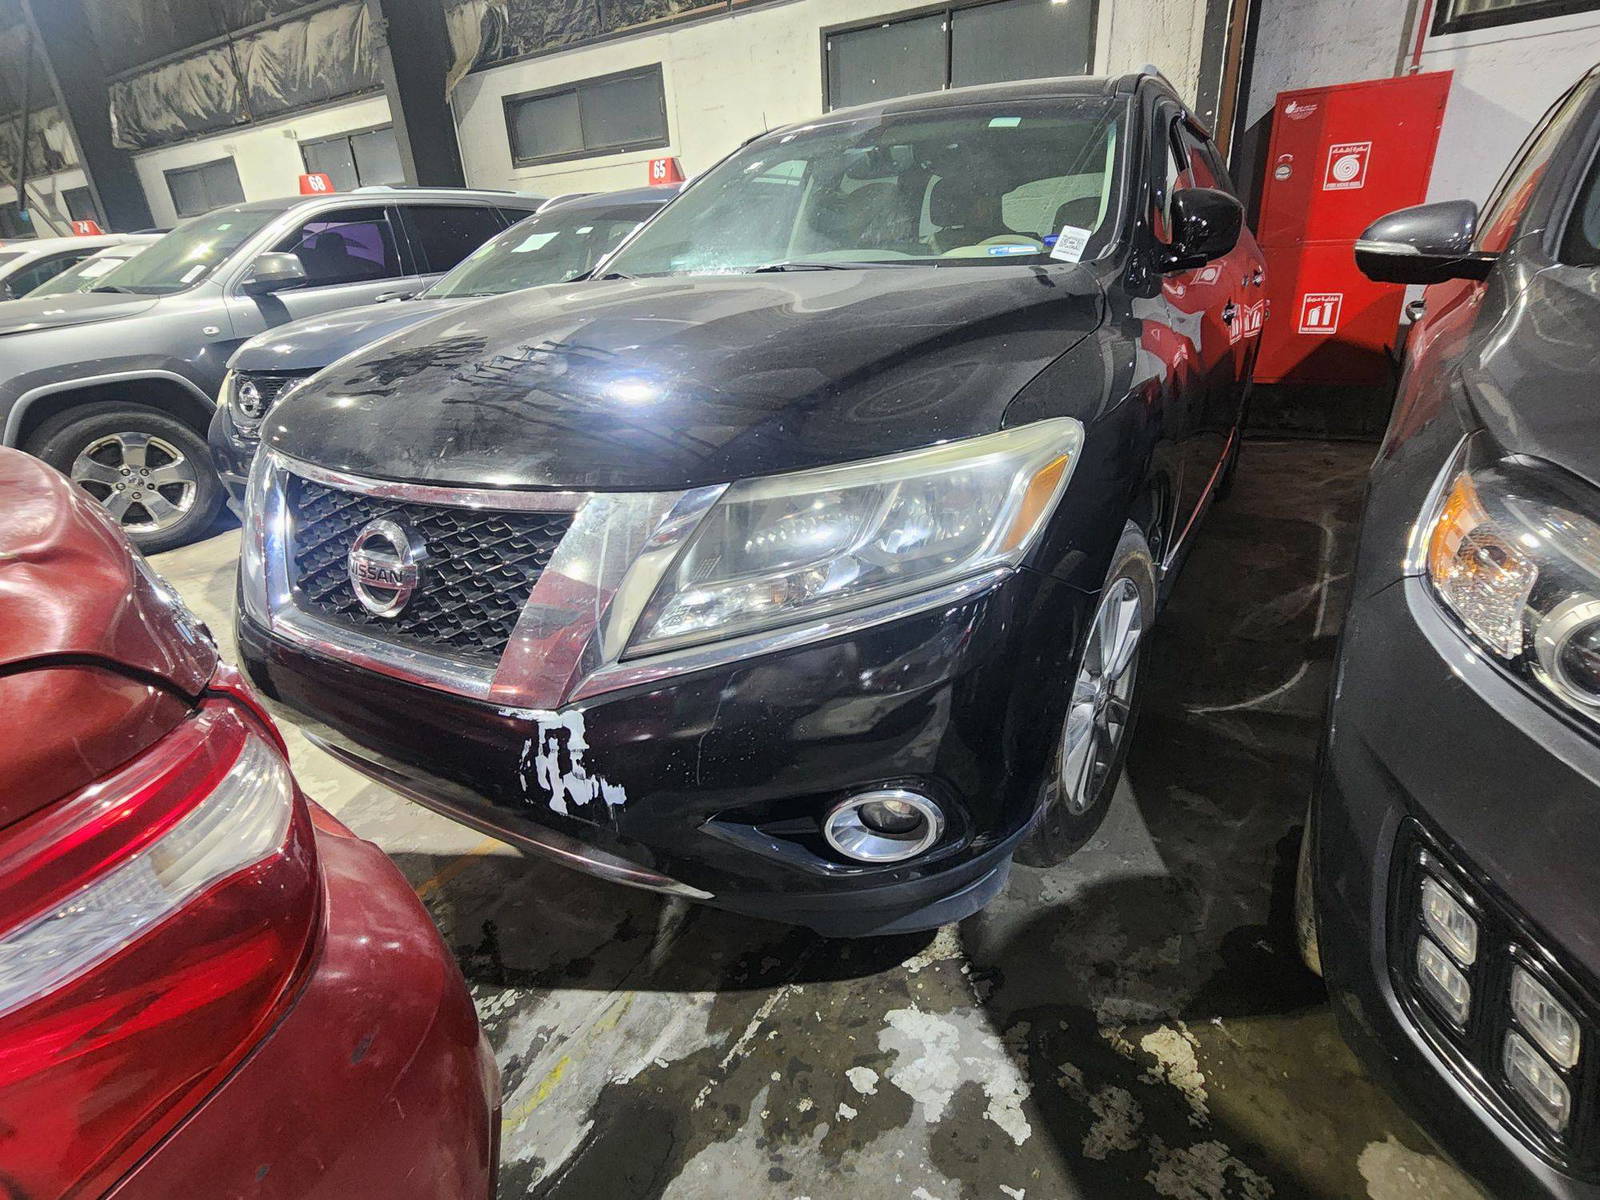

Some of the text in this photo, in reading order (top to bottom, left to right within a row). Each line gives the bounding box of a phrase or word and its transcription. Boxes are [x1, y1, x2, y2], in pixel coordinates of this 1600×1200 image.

[654, 160, 666, 179] 65
[308, 175, 326, 192] 68
[350, 560, 403, 583] NISSAN
